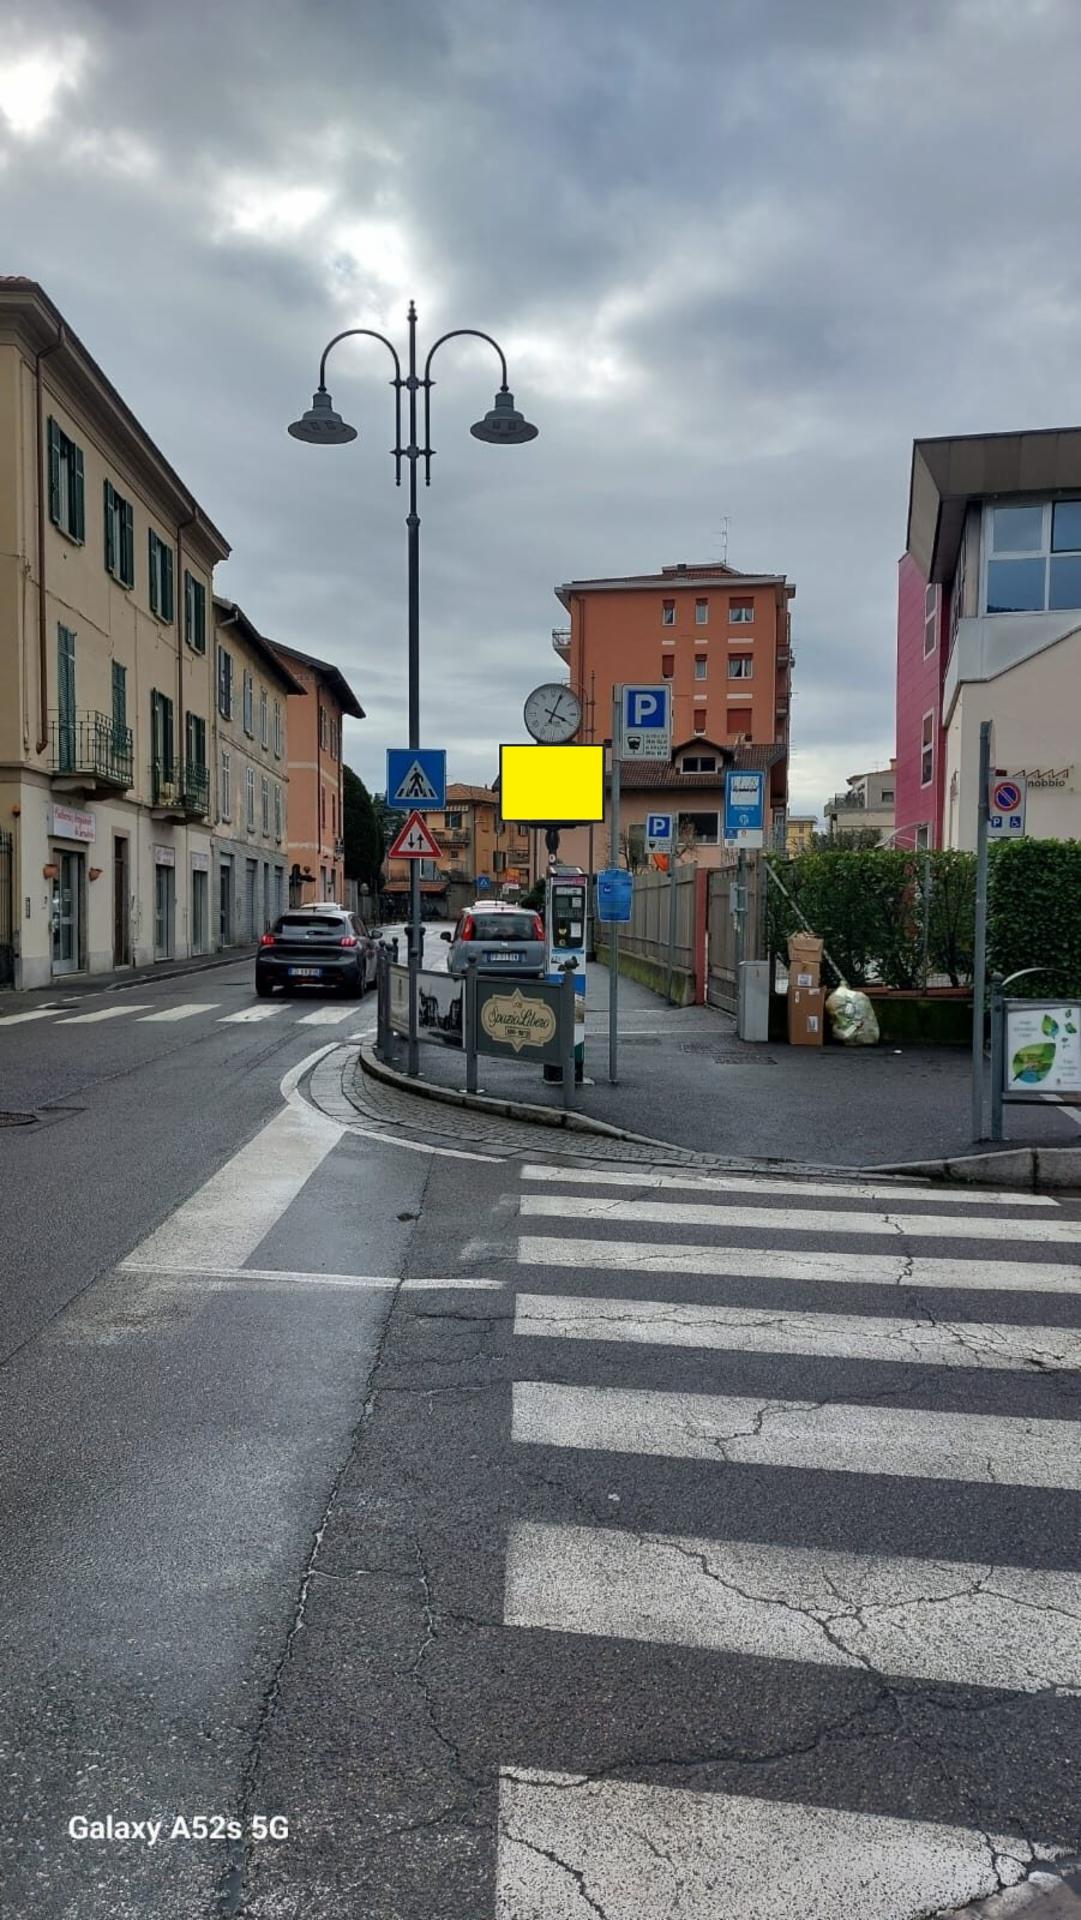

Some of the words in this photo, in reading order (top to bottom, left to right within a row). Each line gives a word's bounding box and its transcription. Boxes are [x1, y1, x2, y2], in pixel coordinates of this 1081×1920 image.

[635, 694, 657, 724] P
[1028, 779, 1066, 787] nobbio
[653, 818, 666, 836] P
[993, 818, 1000, 827] P
[488, 1007, 520, 1028] Spazio
[520, 1009, 550, 1028] Libero
